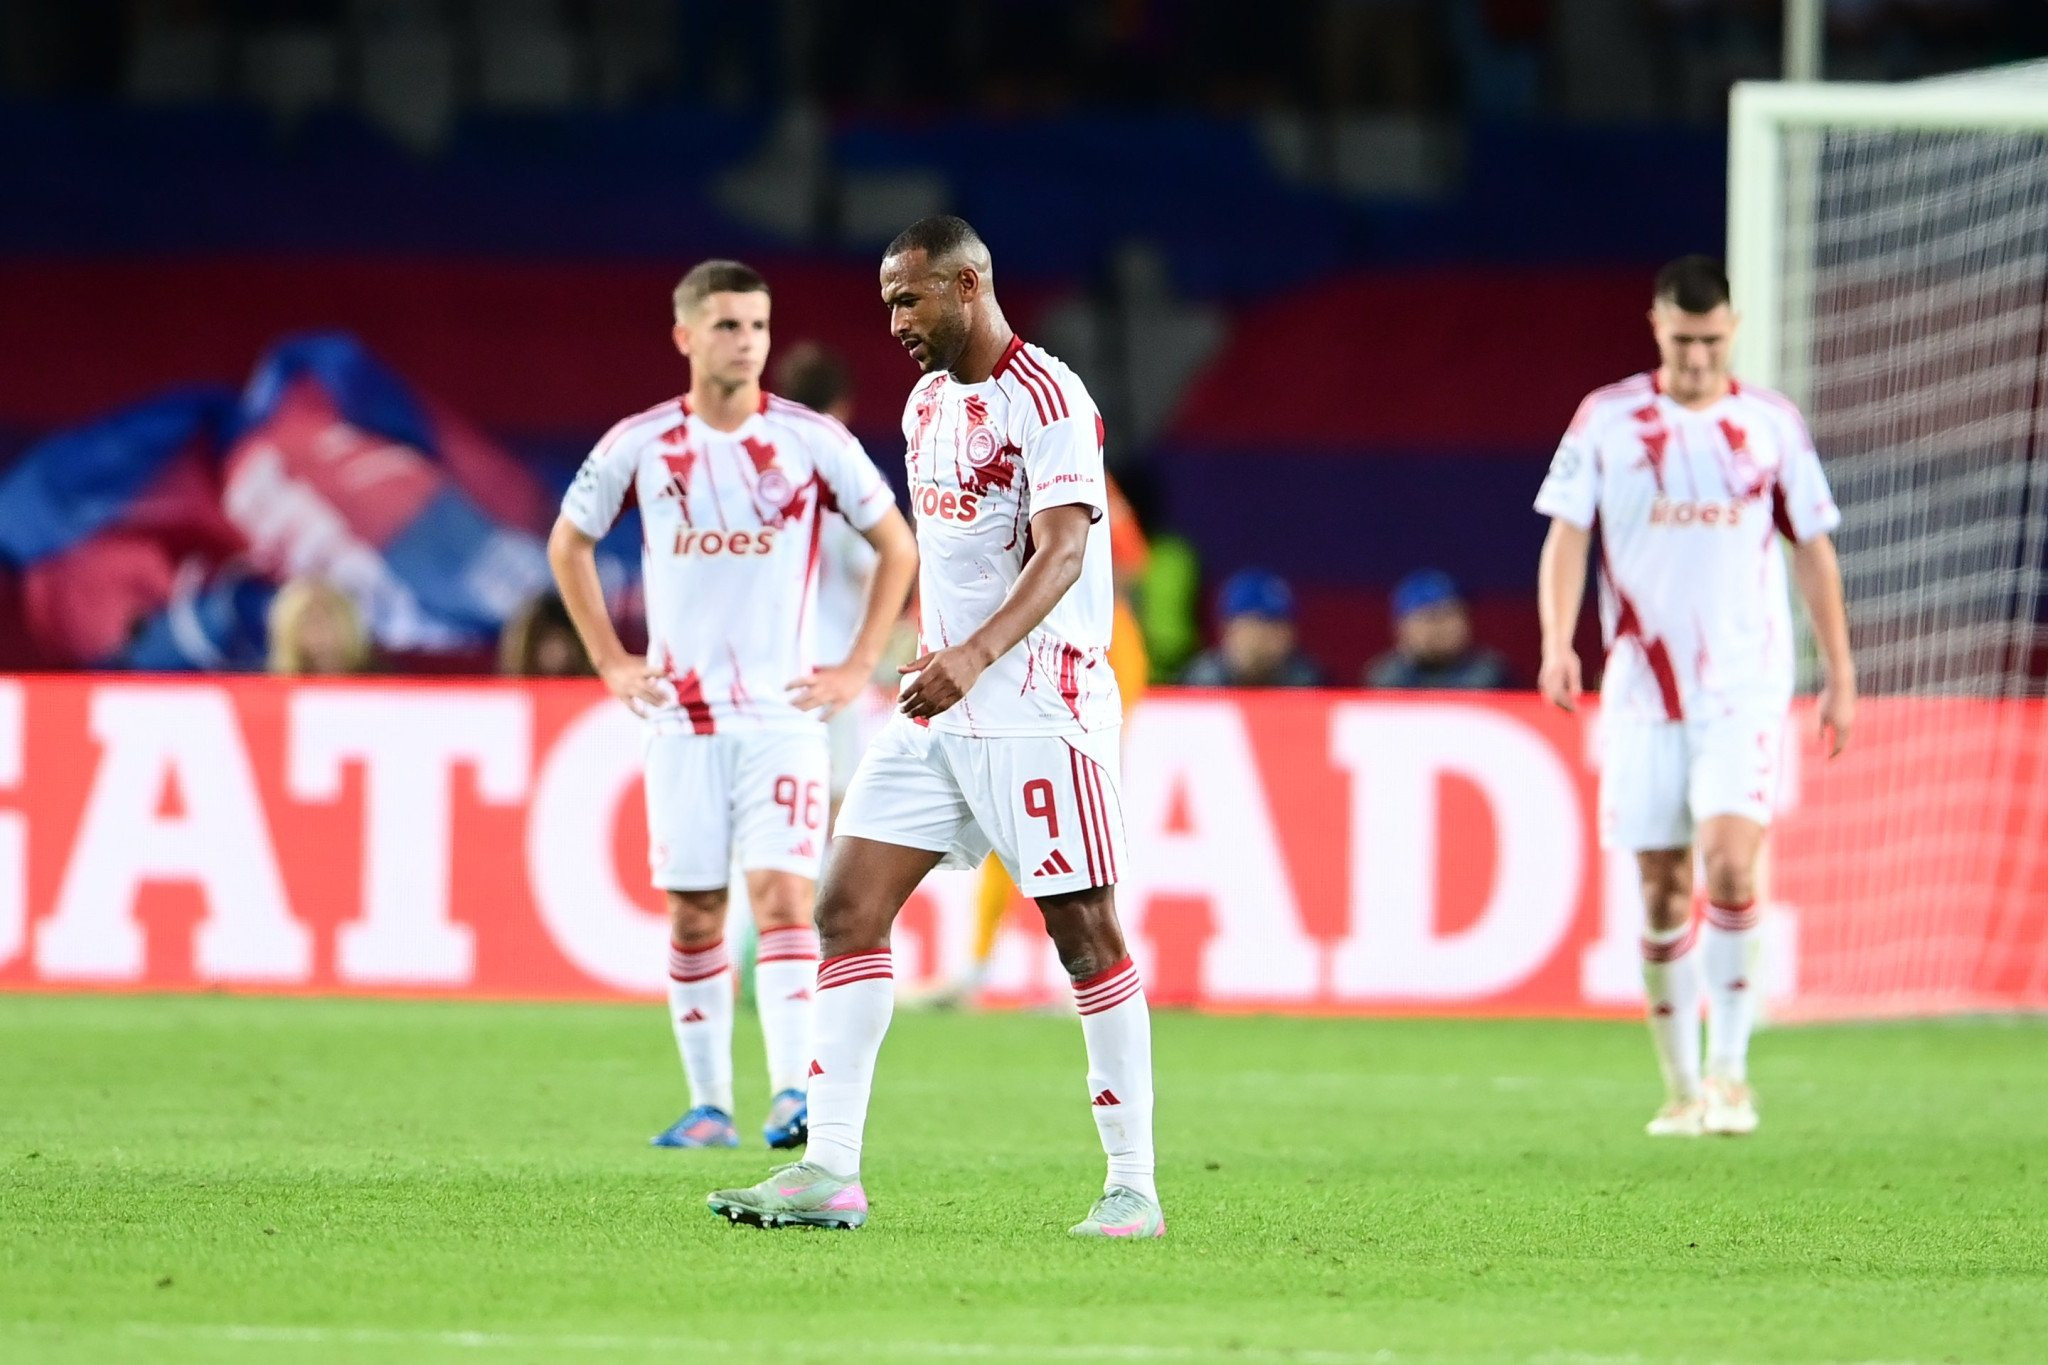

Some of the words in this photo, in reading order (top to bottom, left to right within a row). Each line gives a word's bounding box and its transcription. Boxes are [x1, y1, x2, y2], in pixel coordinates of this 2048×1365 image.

[673, 525, 776, 556] iroes
[773, 774, 823, 830] 96
[1022, 778, 1060, 839] 9
